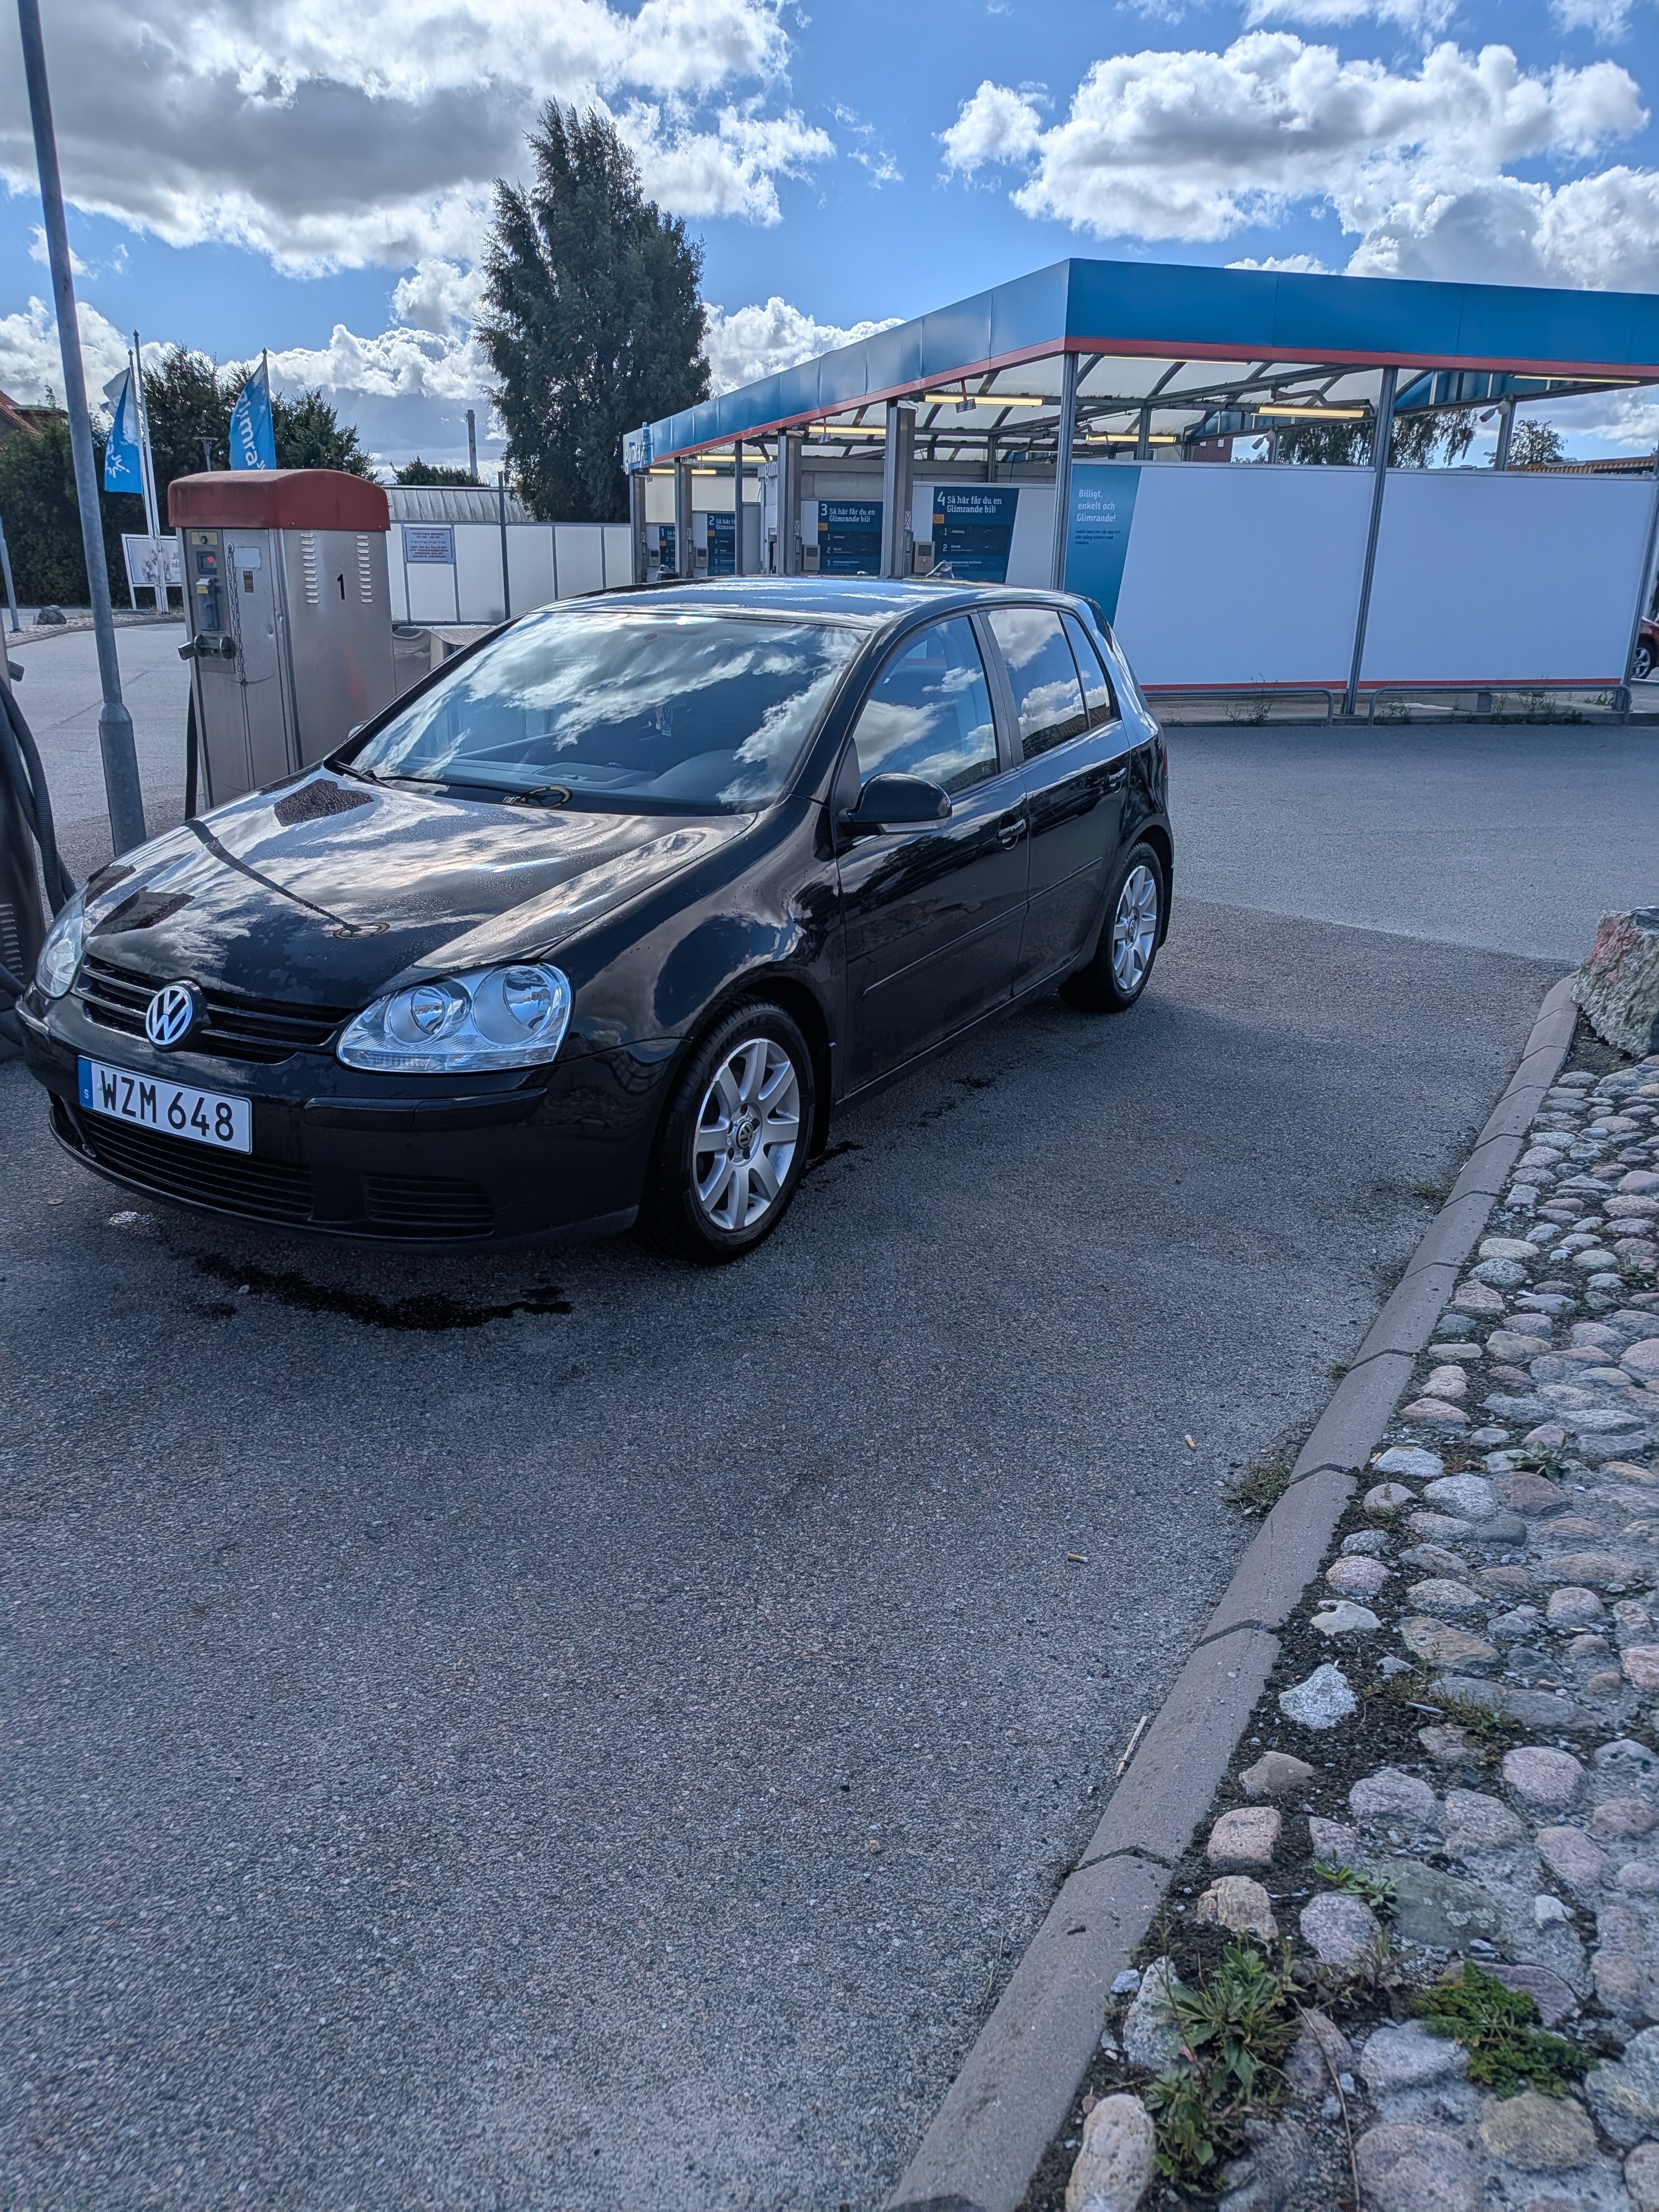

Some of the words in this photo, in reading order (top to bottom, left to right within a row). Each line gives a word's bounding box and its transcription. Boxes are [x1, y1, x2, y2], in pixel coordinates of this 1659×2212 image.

[937, 491, 945, 506] 4
[947, 495, 956, 504] Så
[957, 495, 969, 504] här
[971, 496, 981, 504] får
[983, 496, 992, 504] du
[821, 504, 827, 516] 3
[947, 505, 983, 513] Glimrande
[1078, 501, 1101, 510] enkelt
[1103, 502, 1115, 510] och
[709, 515, 714, 525] 2
[1077, 513, 1116, 522] Glimrande!
[337, 574, 345, 600] 1
[84, 1089, 90, 1099] S
[101, 1070, 157, 1124] WZM
[168, 1092, 233, 1141] 648
